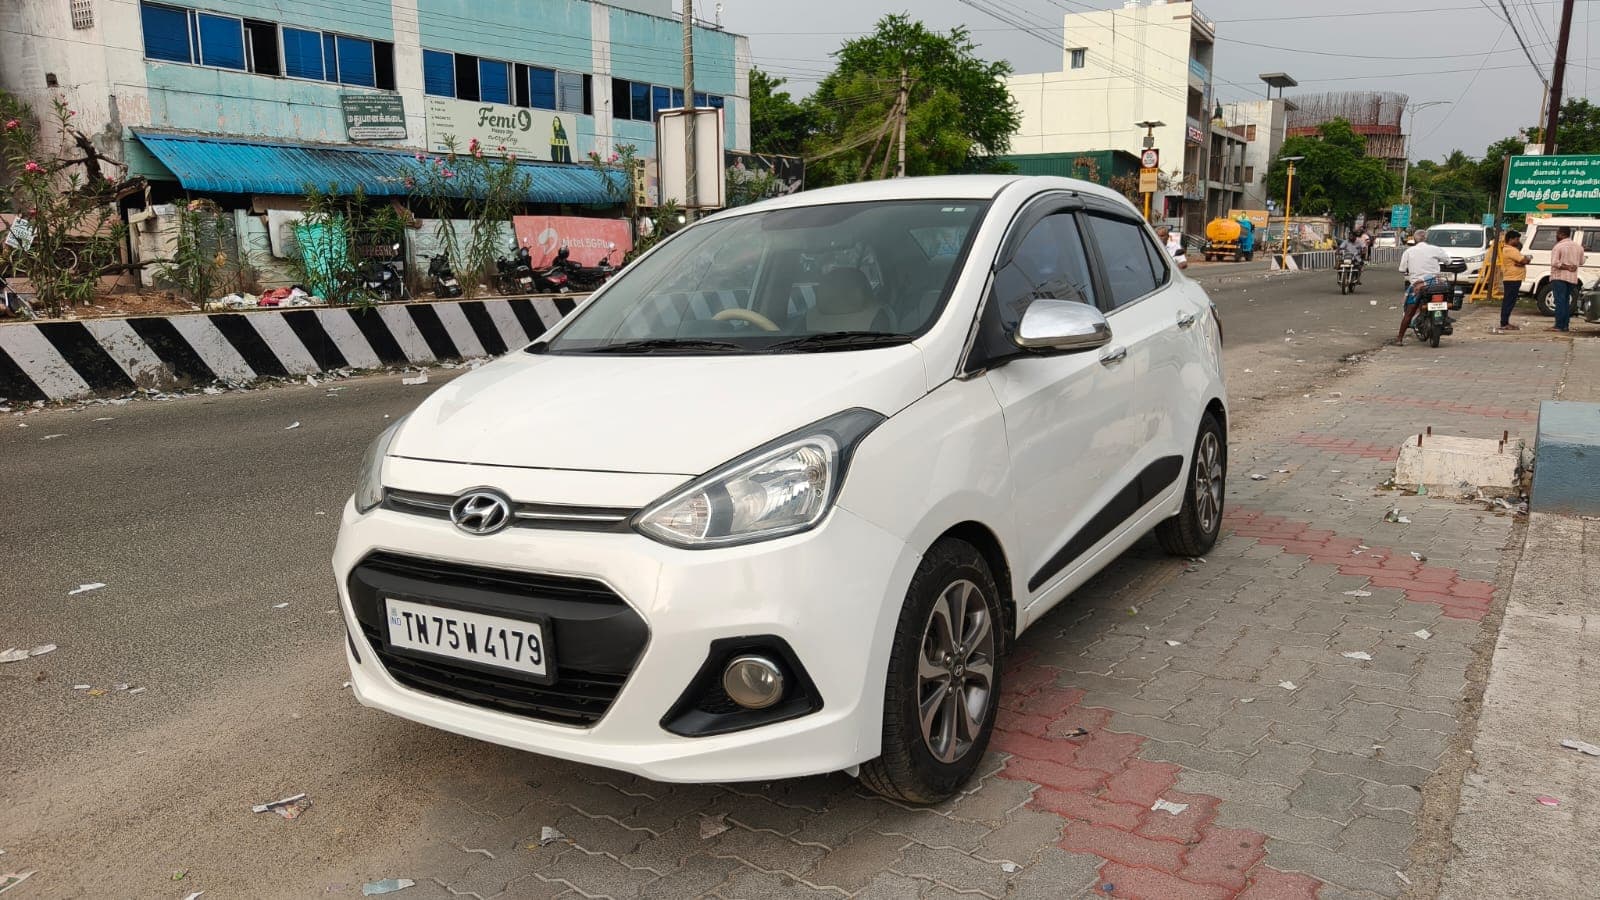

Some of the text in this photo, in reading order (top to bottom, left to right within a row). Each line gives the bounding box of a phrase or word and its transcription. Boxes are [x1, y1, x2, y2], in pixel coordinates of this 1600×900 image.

[478, 105, 532, 131] Femi9
[1508, 187, 1600, 201] அறிவுத்திருக்கோயி
[402, 611, 543, 666] TN75W4179
